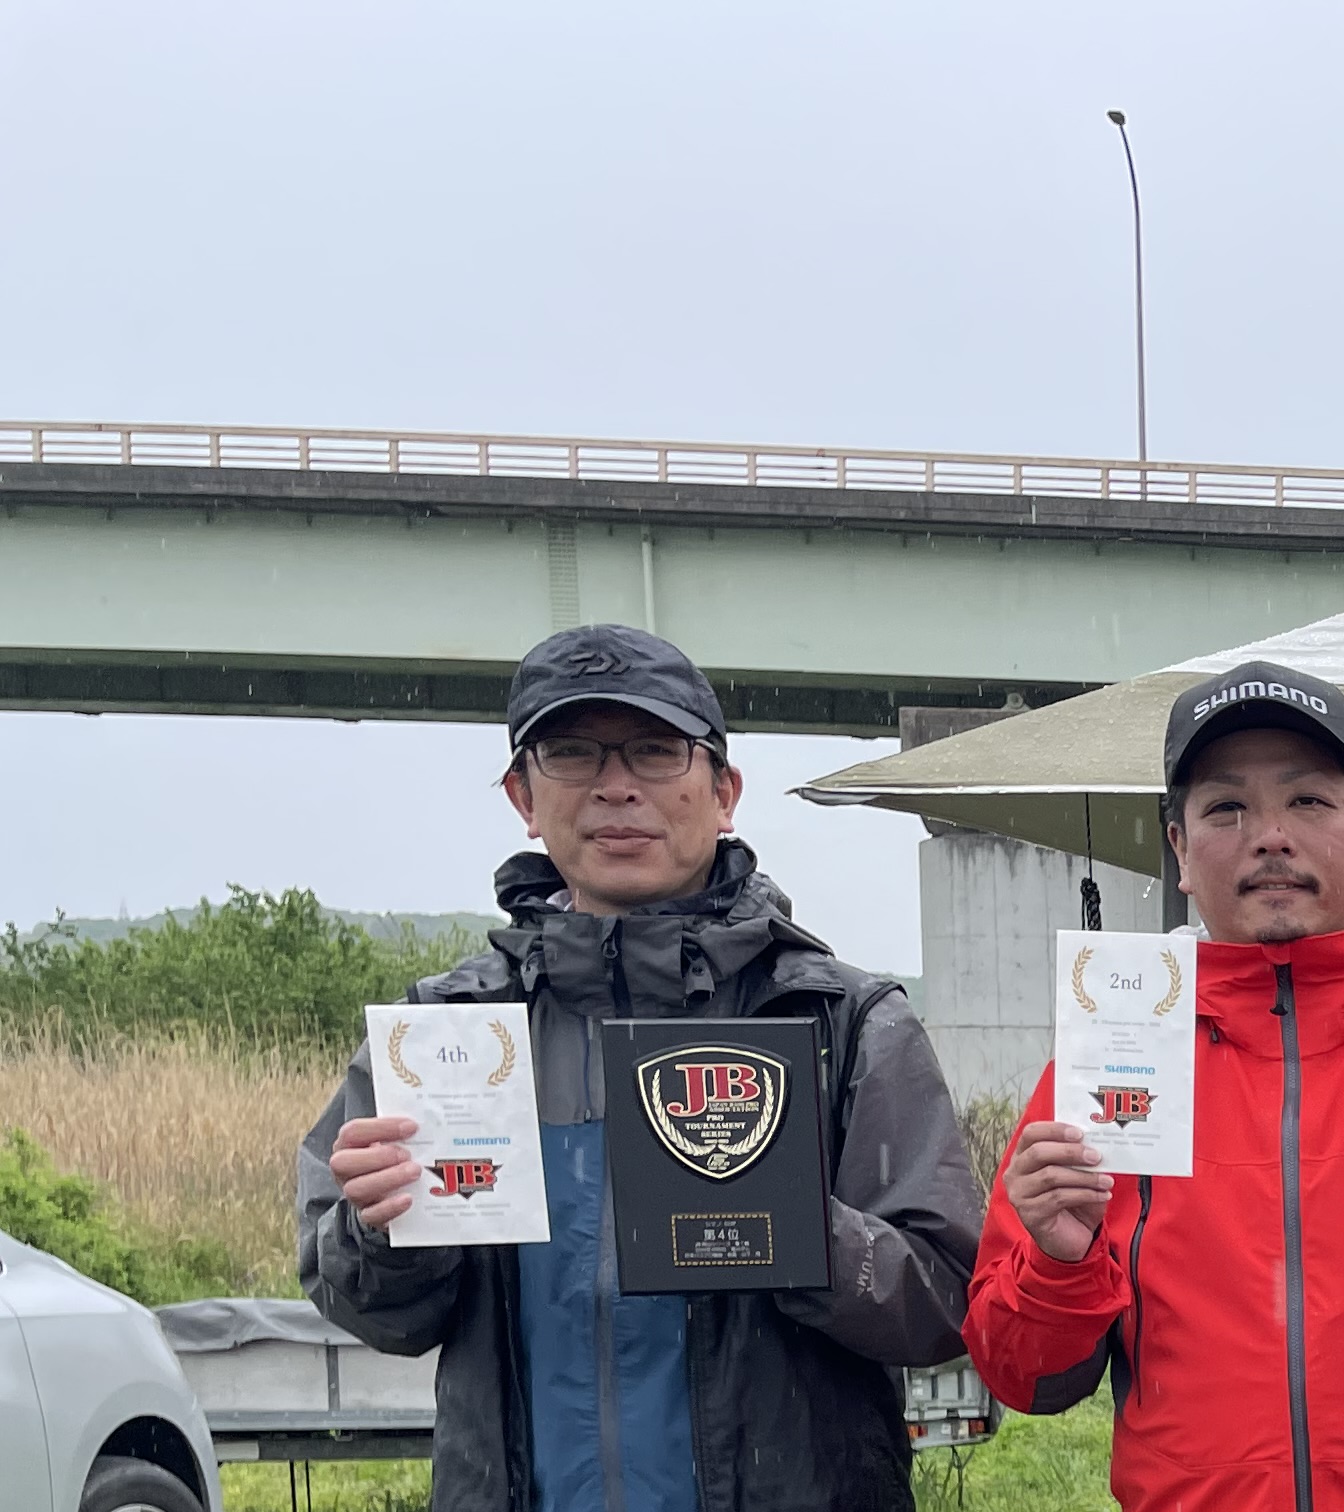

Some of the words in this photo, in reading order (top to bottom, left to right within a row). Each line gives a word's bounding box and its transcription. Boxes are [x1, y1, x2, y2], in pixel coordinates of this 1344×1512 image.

[1193, 680, 1329, 721] SHIMANO
[1109, 973, 1142, 990] 2nd
[436, 1045, 469, 1064] 4th
[1104, 1064, 1156, 1076] SHIMANO
[666, 1063, 761, 1117] JB
[1090, 1090, 1151, 1124] JB
[429, 1161, 498, 1197] JB
